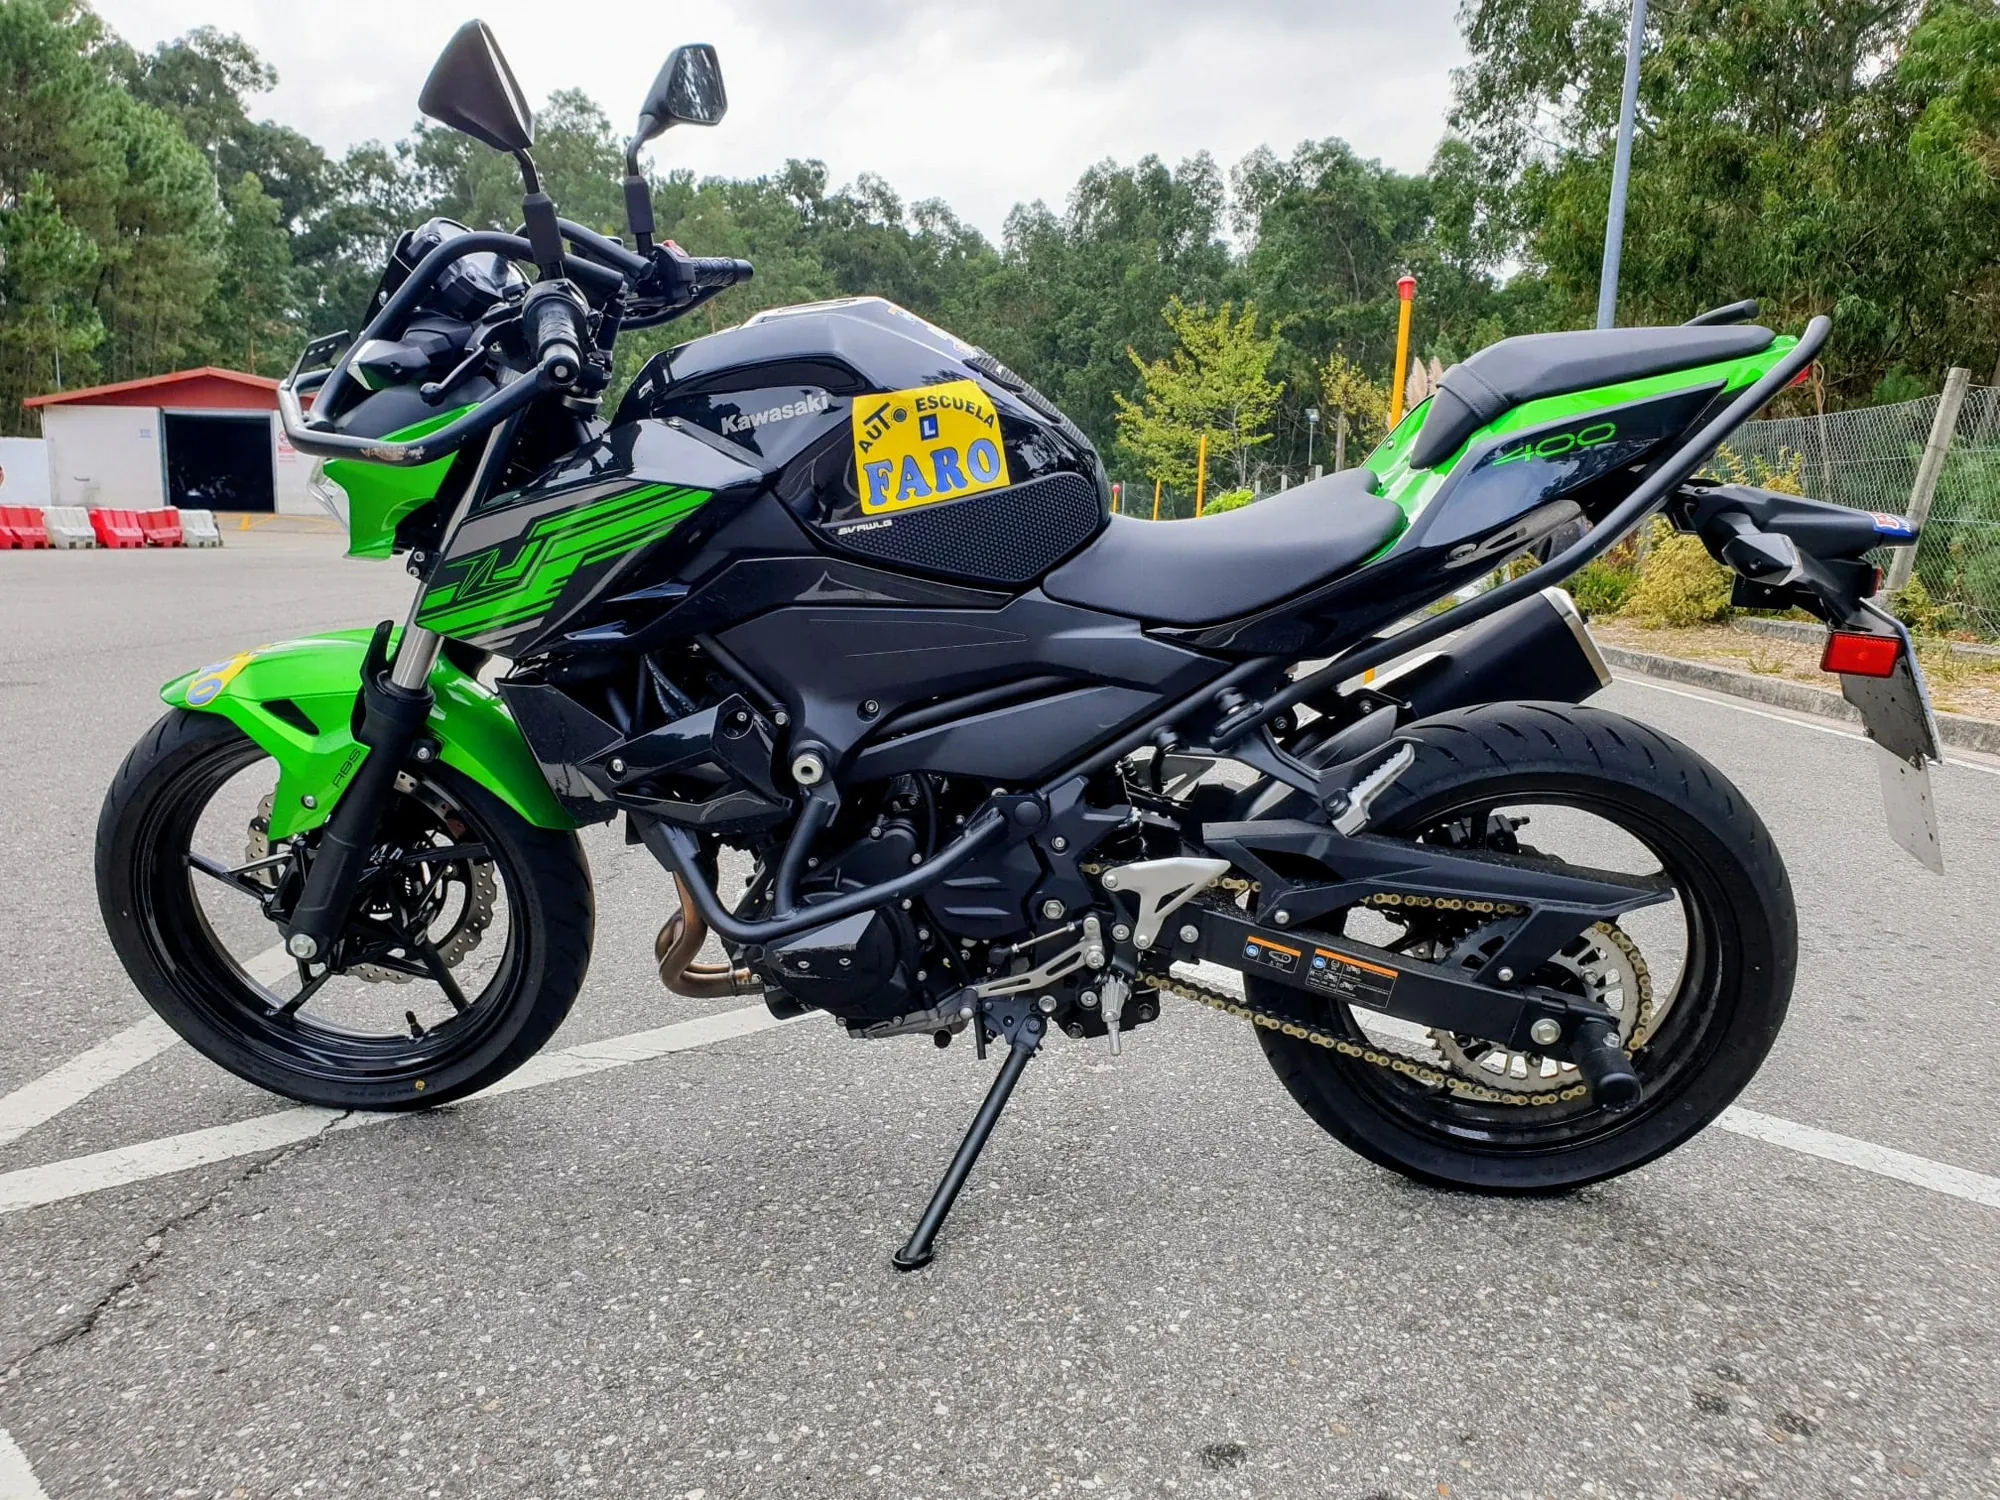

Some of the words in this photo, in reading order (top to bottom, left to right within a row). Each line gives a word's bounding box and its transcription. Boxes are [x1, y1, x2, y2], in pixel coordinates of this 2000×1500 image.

[720, 390, 829, 436] Kawasaki
[915, 395, 996, 429] ESCUELA
[1491, 422, 1616, 465] 400
[862, 437, 1001, 507] FARO
[332, 747, 361, 788] ABS
